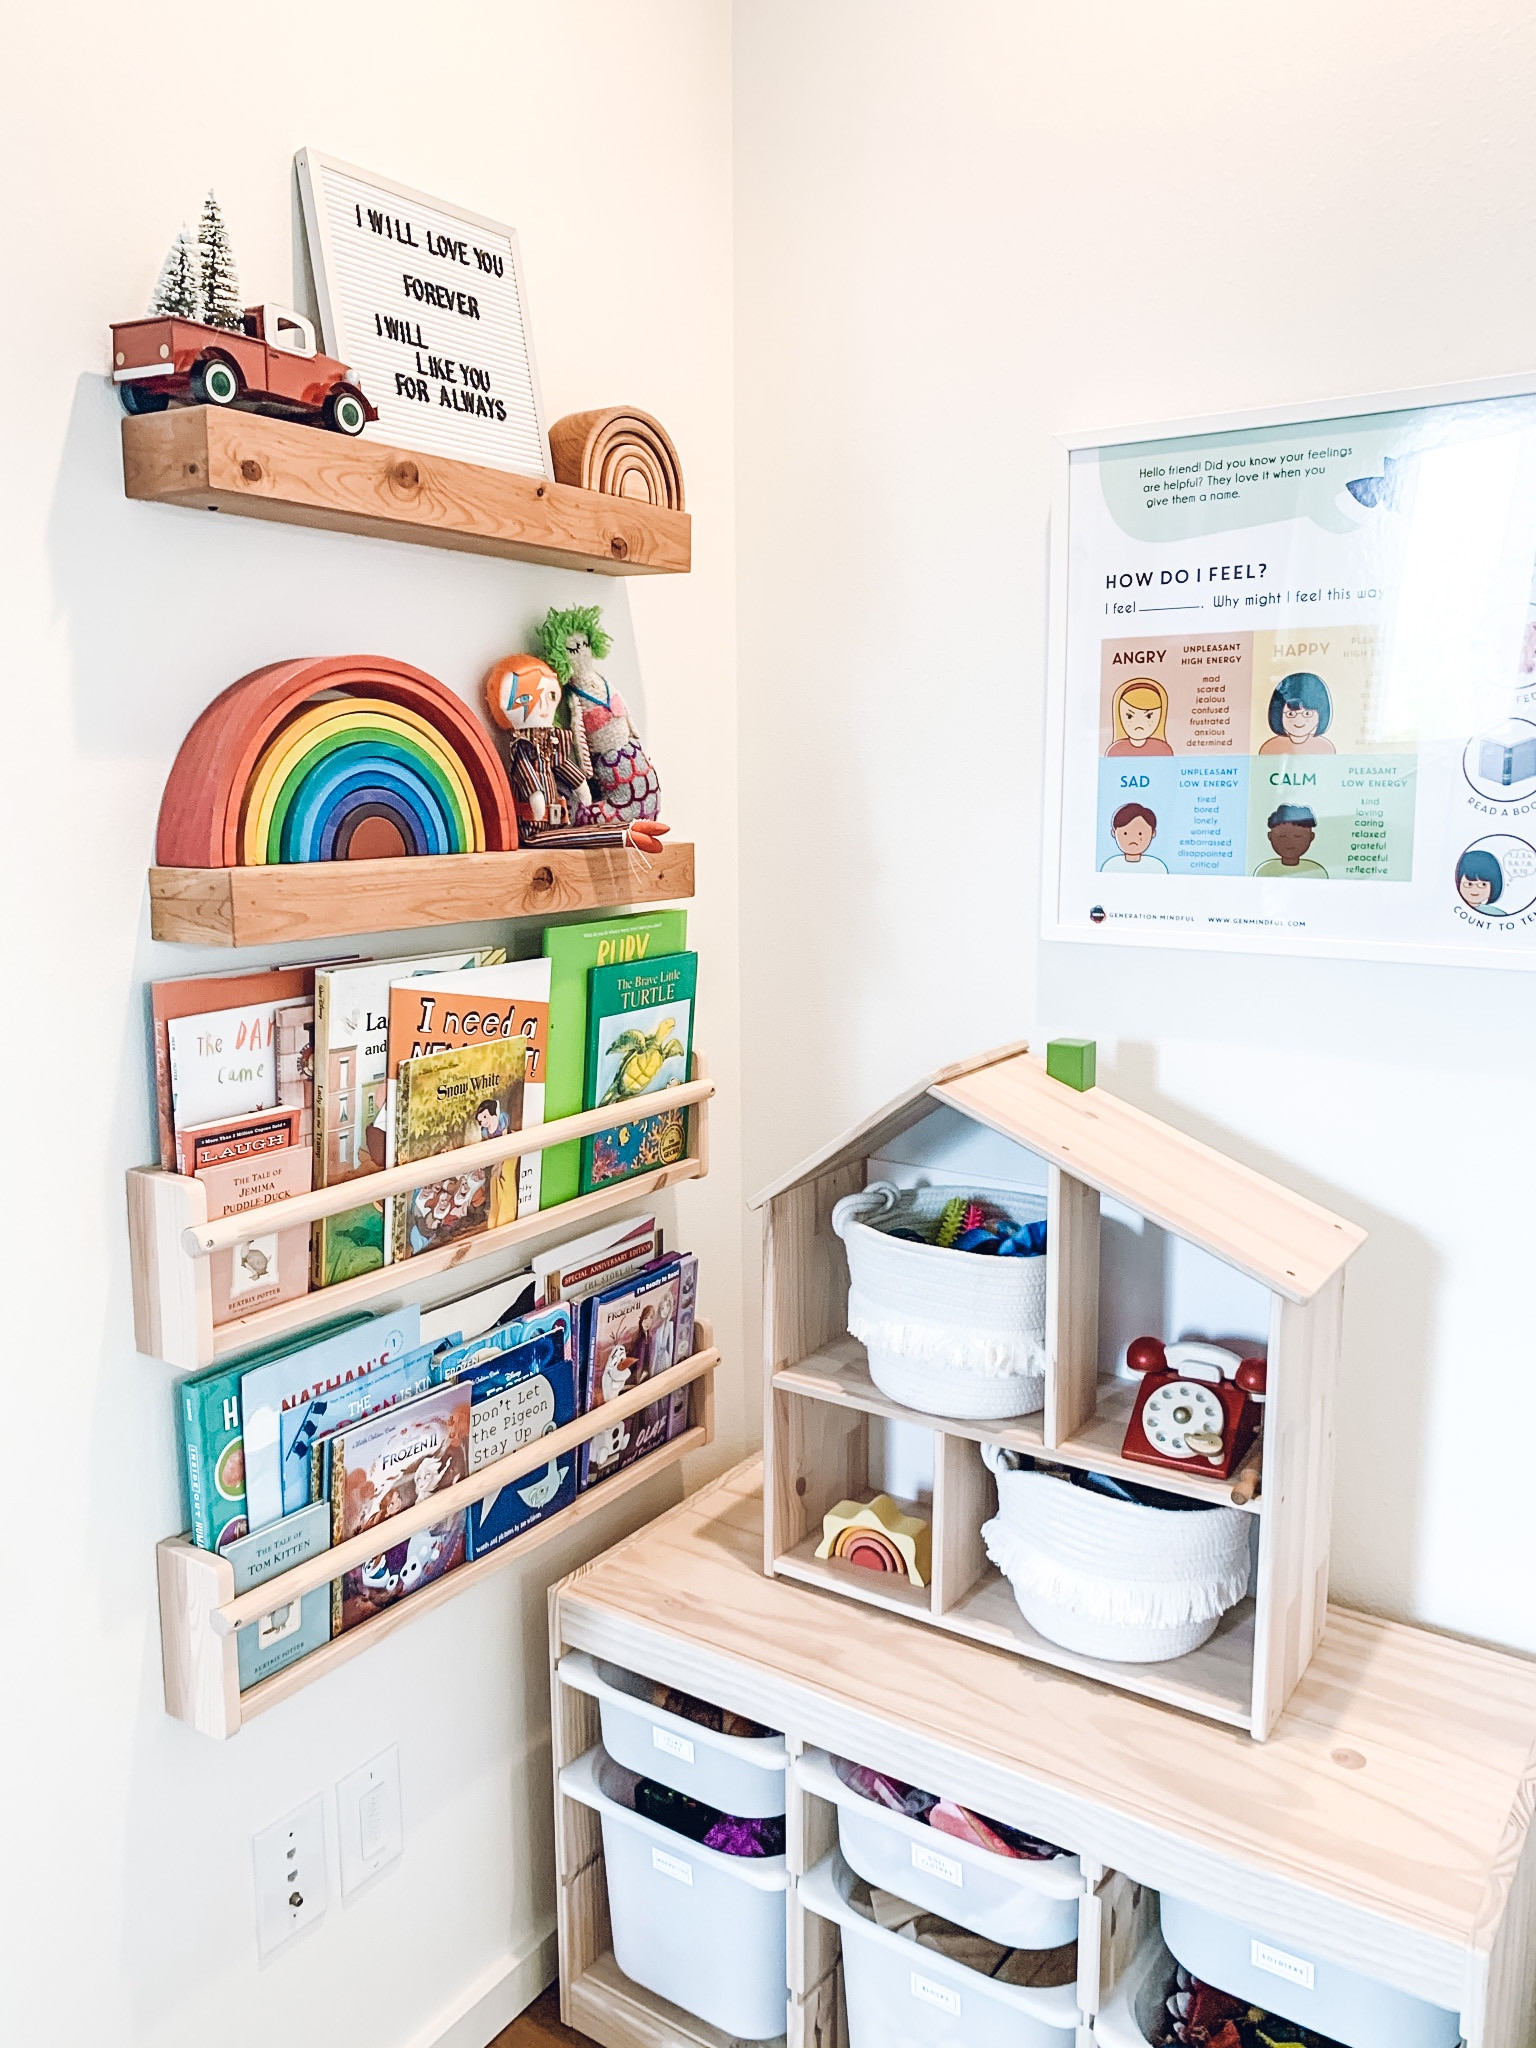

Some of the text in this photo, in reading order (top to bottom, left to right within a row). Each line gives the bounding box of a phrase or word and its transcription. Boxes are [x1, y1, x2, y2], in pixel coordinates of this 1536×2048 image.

[356, 204, 504, 278] I WILL LOVE YOU
[403, 274, 480, 320] FOREVER
[375, 313, 429, 349] I WILL
[416, 352, 491, 393] LIKE YOU
[395, 372, 507, 421] FOR ALWAYS
[1139, 447, 1353, 478] Hello friend! Did you know your feelings
[1143, 465, 1326, 493] are helpful? They love it when you
[1146, 490, 1241, 508] give them a name.
[1106, 563, 1267, 589] HOW DO I FEEL?
[1105, 602, 1109, 615] I
[1113, 601, 1136, 614] feel
[1213, 594, 1240, 608] Why
[1245, 592, 1281, 607] might
[1296, 588, 1322, 603] feel
[1327, 588, 1351, 601] this
[1183, 643, 1241, 653] UNPLEASANT
[1273, 642, 1331, 658] HAPPY
[1112, 649, 1167, 665] ANGRY
[1181, 655, 1242, 666] HIGH ENERGY
[1202, 675, 1221, 683] mad
[1196, 685, 1226, 694] scared
[1195, 695, 1226, 704] jealous
[1191, 705, 1230, 714] confused
[1189, 717, 1231, 726] frustrated
[1194, 728, 1225, 736] anxious
[1186, 738, 1233, 747] determined
[1181, 768, 1238, 776] UNPLEASANT
[1348, 767, 1397, 775] PLEASANT
[1120, 775, 1150, 788] SAD
[1179, 780, 1239, 788] LOW ENERGY
[1269, 773, 1317, 786] CALM
[1342, 779, 1408, 788] LOW ENERGY
[1193, 805, 1219, 814] bored
[1361, 798, 1379, 806] kind
[1467, 797, 1497, 815] READ
[1501, 808, 1509, 817] A
[1193, 817, 1218, 825] lonely
[1356, 809, 1384, 817] loving
[1190, 828, 1221, 836] worried
[1354, 820, 1384, 828] caring
[1179, 839, 1232, 847] embarrassed
[1351, 831, 1386, 839] relaxed
[1177, 849, 1233, 858] disappointed
[1350, 842, 1387, 851] grateful
[1190, 860, 1219, 869] critical
[1347, 853, 1388, 862] peaceful
[1346, 866, 1388, 874] reflective
[1109, 912, 1195, 922] GENERATION MINDFUL
[1453, 906, 1515, 931] COUNT TO
[617, 969, 681, 990] The Brave Little
[621, 984, 676, 1009] TURTLE
[418, 997, 538, 1039] I need a
[197, 1030, 223, 1057] The
[365, 1040, 387, 1056] and
[437, 1081, 468, 1101] Snow
[470, 1073, 500, 1092] White
[315, 1084, 324, 1159] Lady Tramp
[202, 1134, 284, 1163] LAUGH
[233, 1167, 282, 1187] THE TALE OF
[238, 1182, 276, 1198] JEMIMA
[223, 1189, 291, 1216] PUDDLE-DUCK
[564, 1243, 651, 1285] SPECIAL ANNIVERSARY EDITION
[228, 1295, 255, 1310] BEATRIX
[256, 1287, 281, 1302] POTTER
[348, 1394, 372, 1417] THE
[471, 1398, 511, 1428] Don't
[518, 1384, 541, 1406] Let
[472, 1400, 548, 1444] the Pigeon
[635, 1415, 667, 1447] OLAF
[382, 1439, 429, 1470] FROZEN
[429, 1433, 438, 1448] II
[474, 1426, 532, 1464] Stay Up
[256, 1531, 303, 1558] THE TALE OF
[248, 1539, 311, 1576] TOM KITTEN
